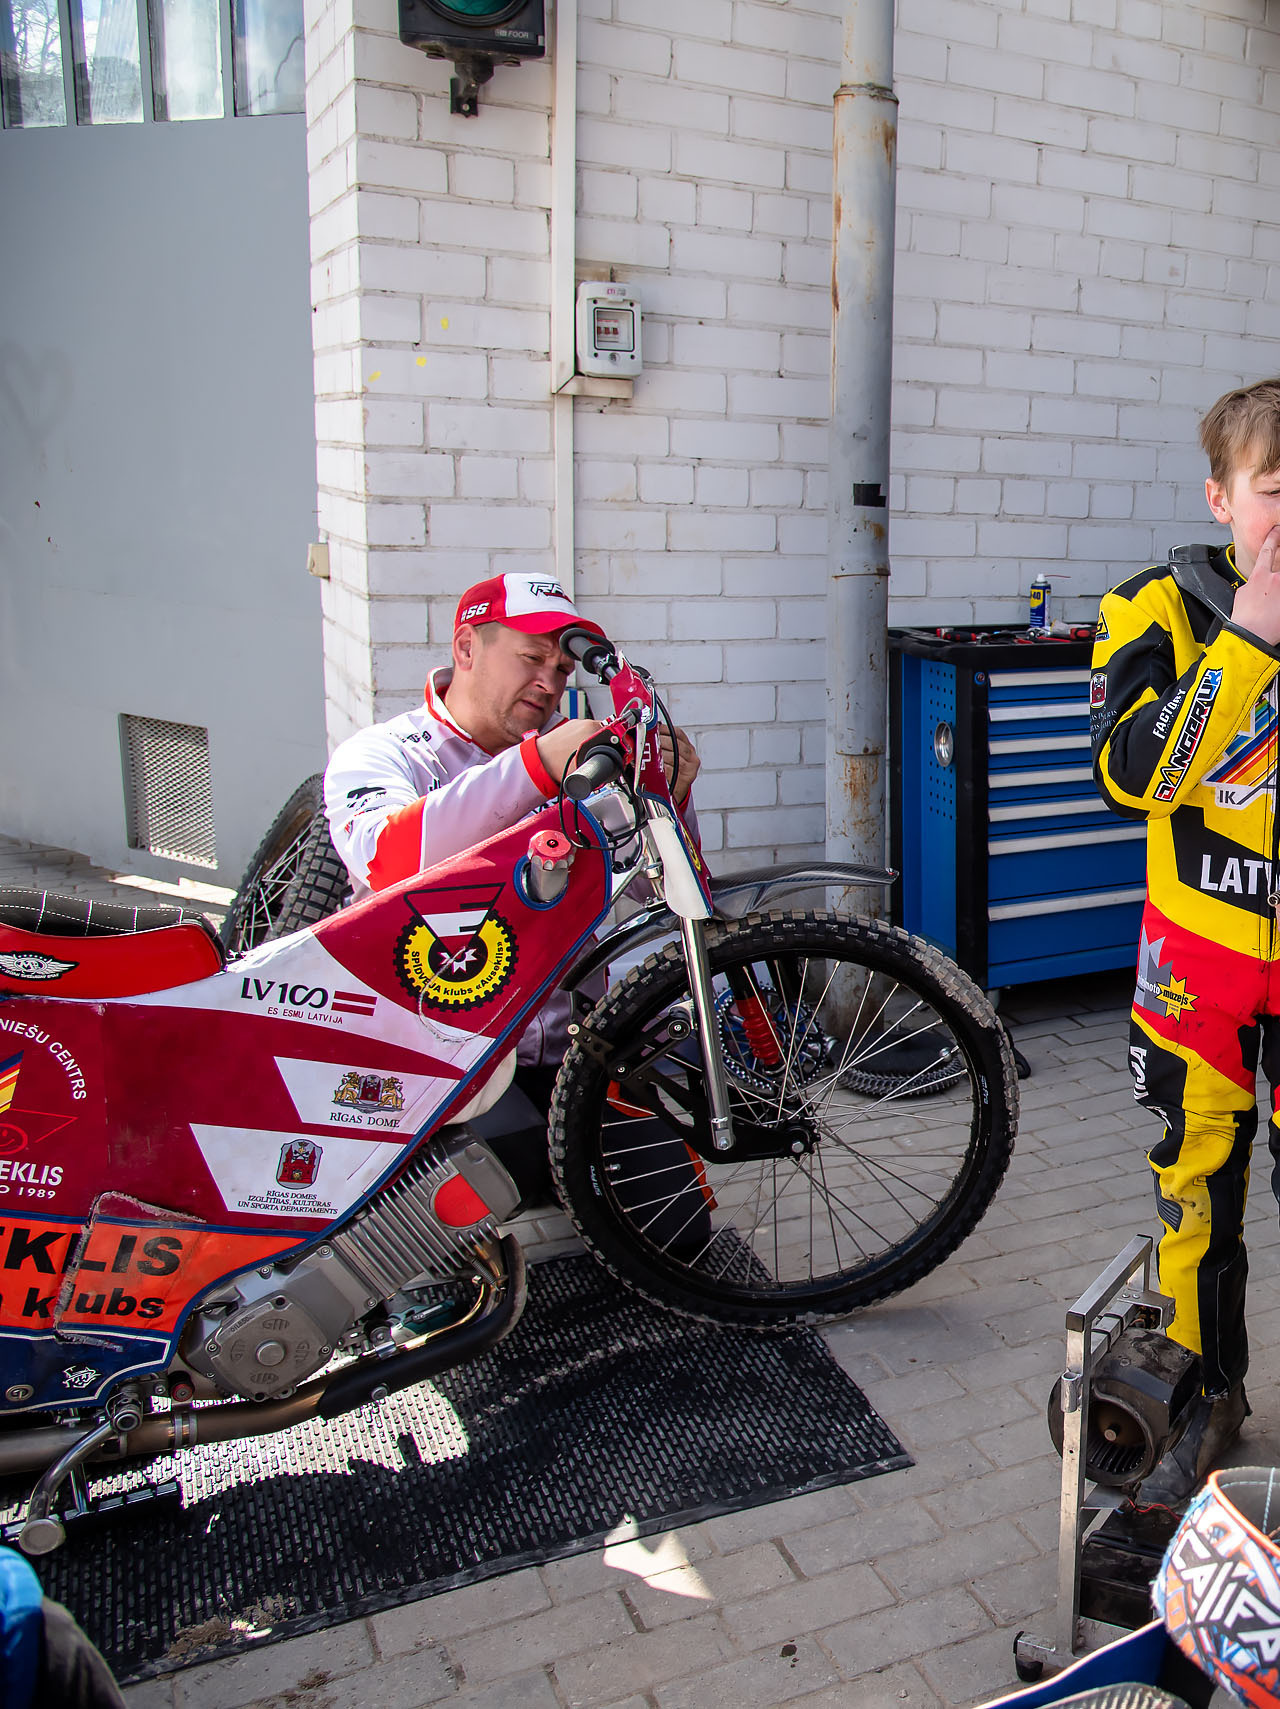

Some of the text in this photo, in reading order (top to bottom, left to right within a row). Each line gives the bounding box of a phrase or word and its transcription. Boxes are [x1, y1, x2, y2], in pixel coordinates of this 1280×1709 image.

[1152, 688, 1186, 740] FACTORY
[1219, 789, 1237, 805] IK
[443, 987, 473, 996] klubs
[267, 1007, 343, 1024] ES ESMU LATVIJA
[50, 1041, 87, 1101] CENTRS
[367, 1116, 400, 1128] DOME
[18, 1186, 57, 1200] 1989
[250, 1202, 280, 1211] SPORTA
[280, 1205, 338, 1215] DEPARTAMENTS
[0, 1226, 184, 1277] KLIS
